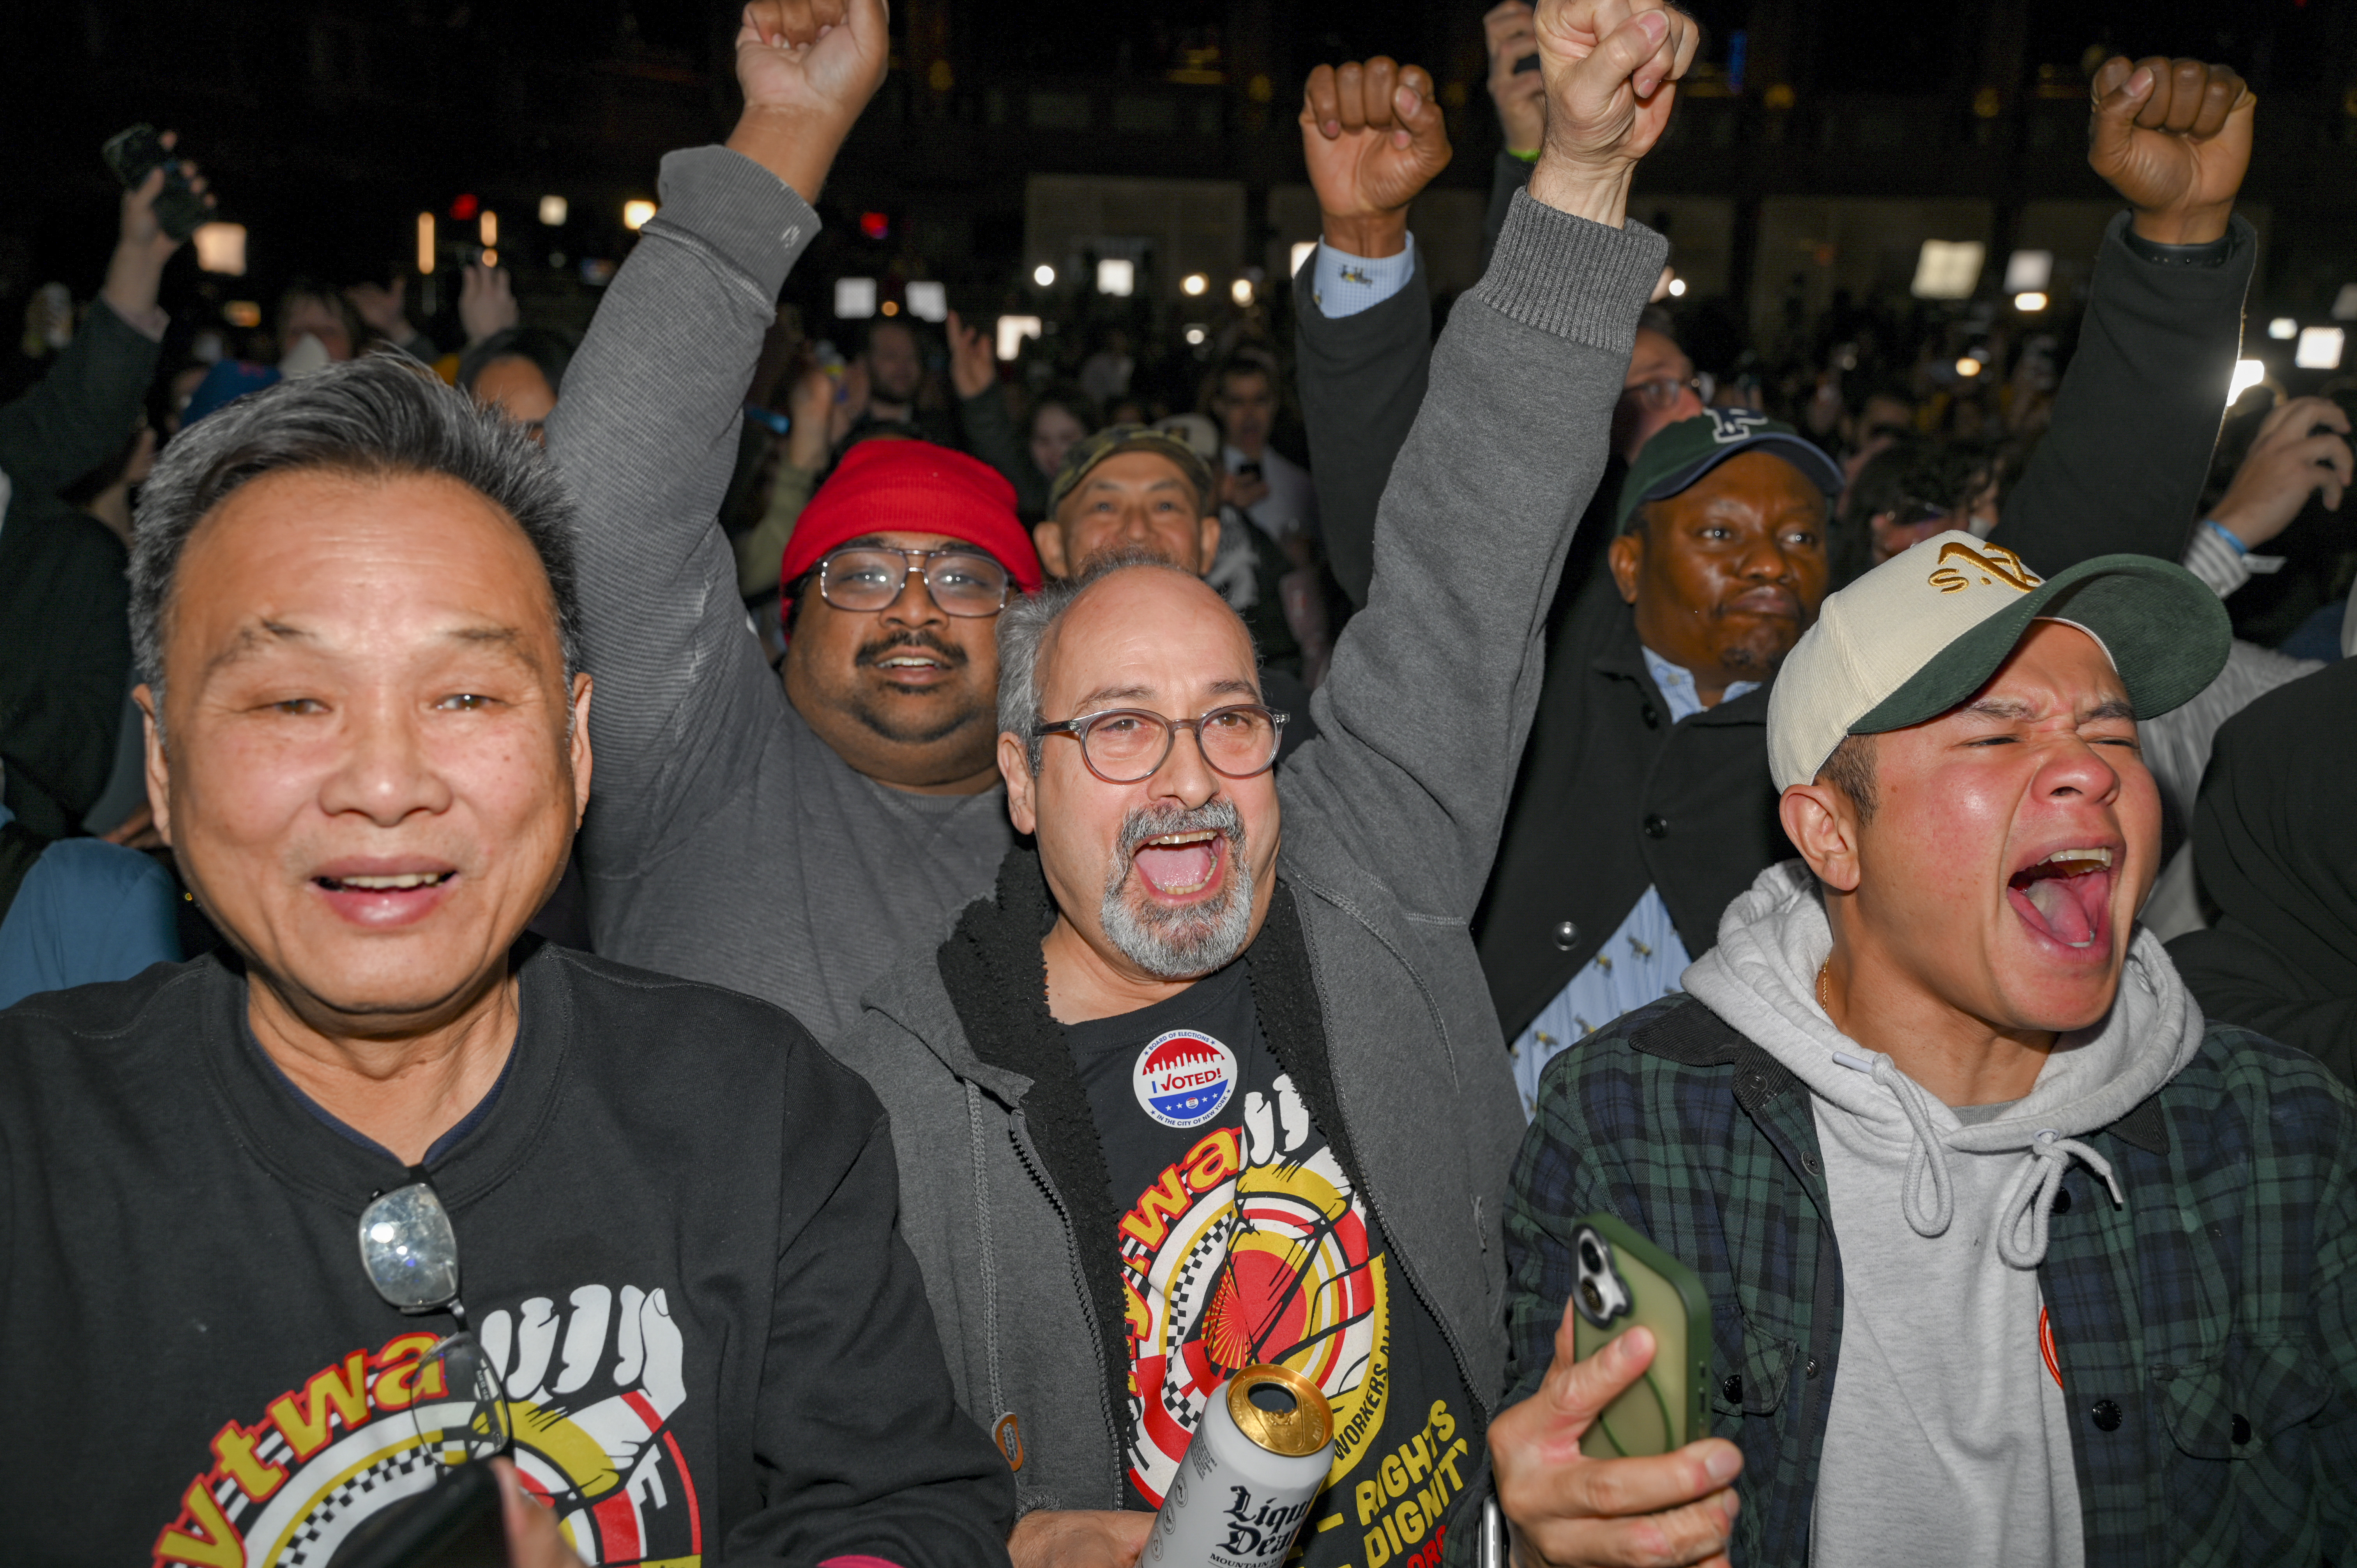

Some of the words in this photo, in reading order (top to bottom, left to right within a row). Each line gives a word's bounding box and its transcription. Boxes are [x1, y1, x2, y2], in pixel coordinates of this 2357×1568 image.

[1148, 1036, 1167, 1051] BOARD
[1178, 1031, 1210, 1042] ELECTIONS
[1152, 1081, 1157, 1093] I
[1161, 1068, 1222, 1091] VOTED!
[1202, 1110, 1215, 1121] NEW
[1214, 1095, 1228, 1111] YORK
[1335, 1363, 1387, 1460] WORKERS
[1210, 1553, 1270, 1568] MOUNTAIN
